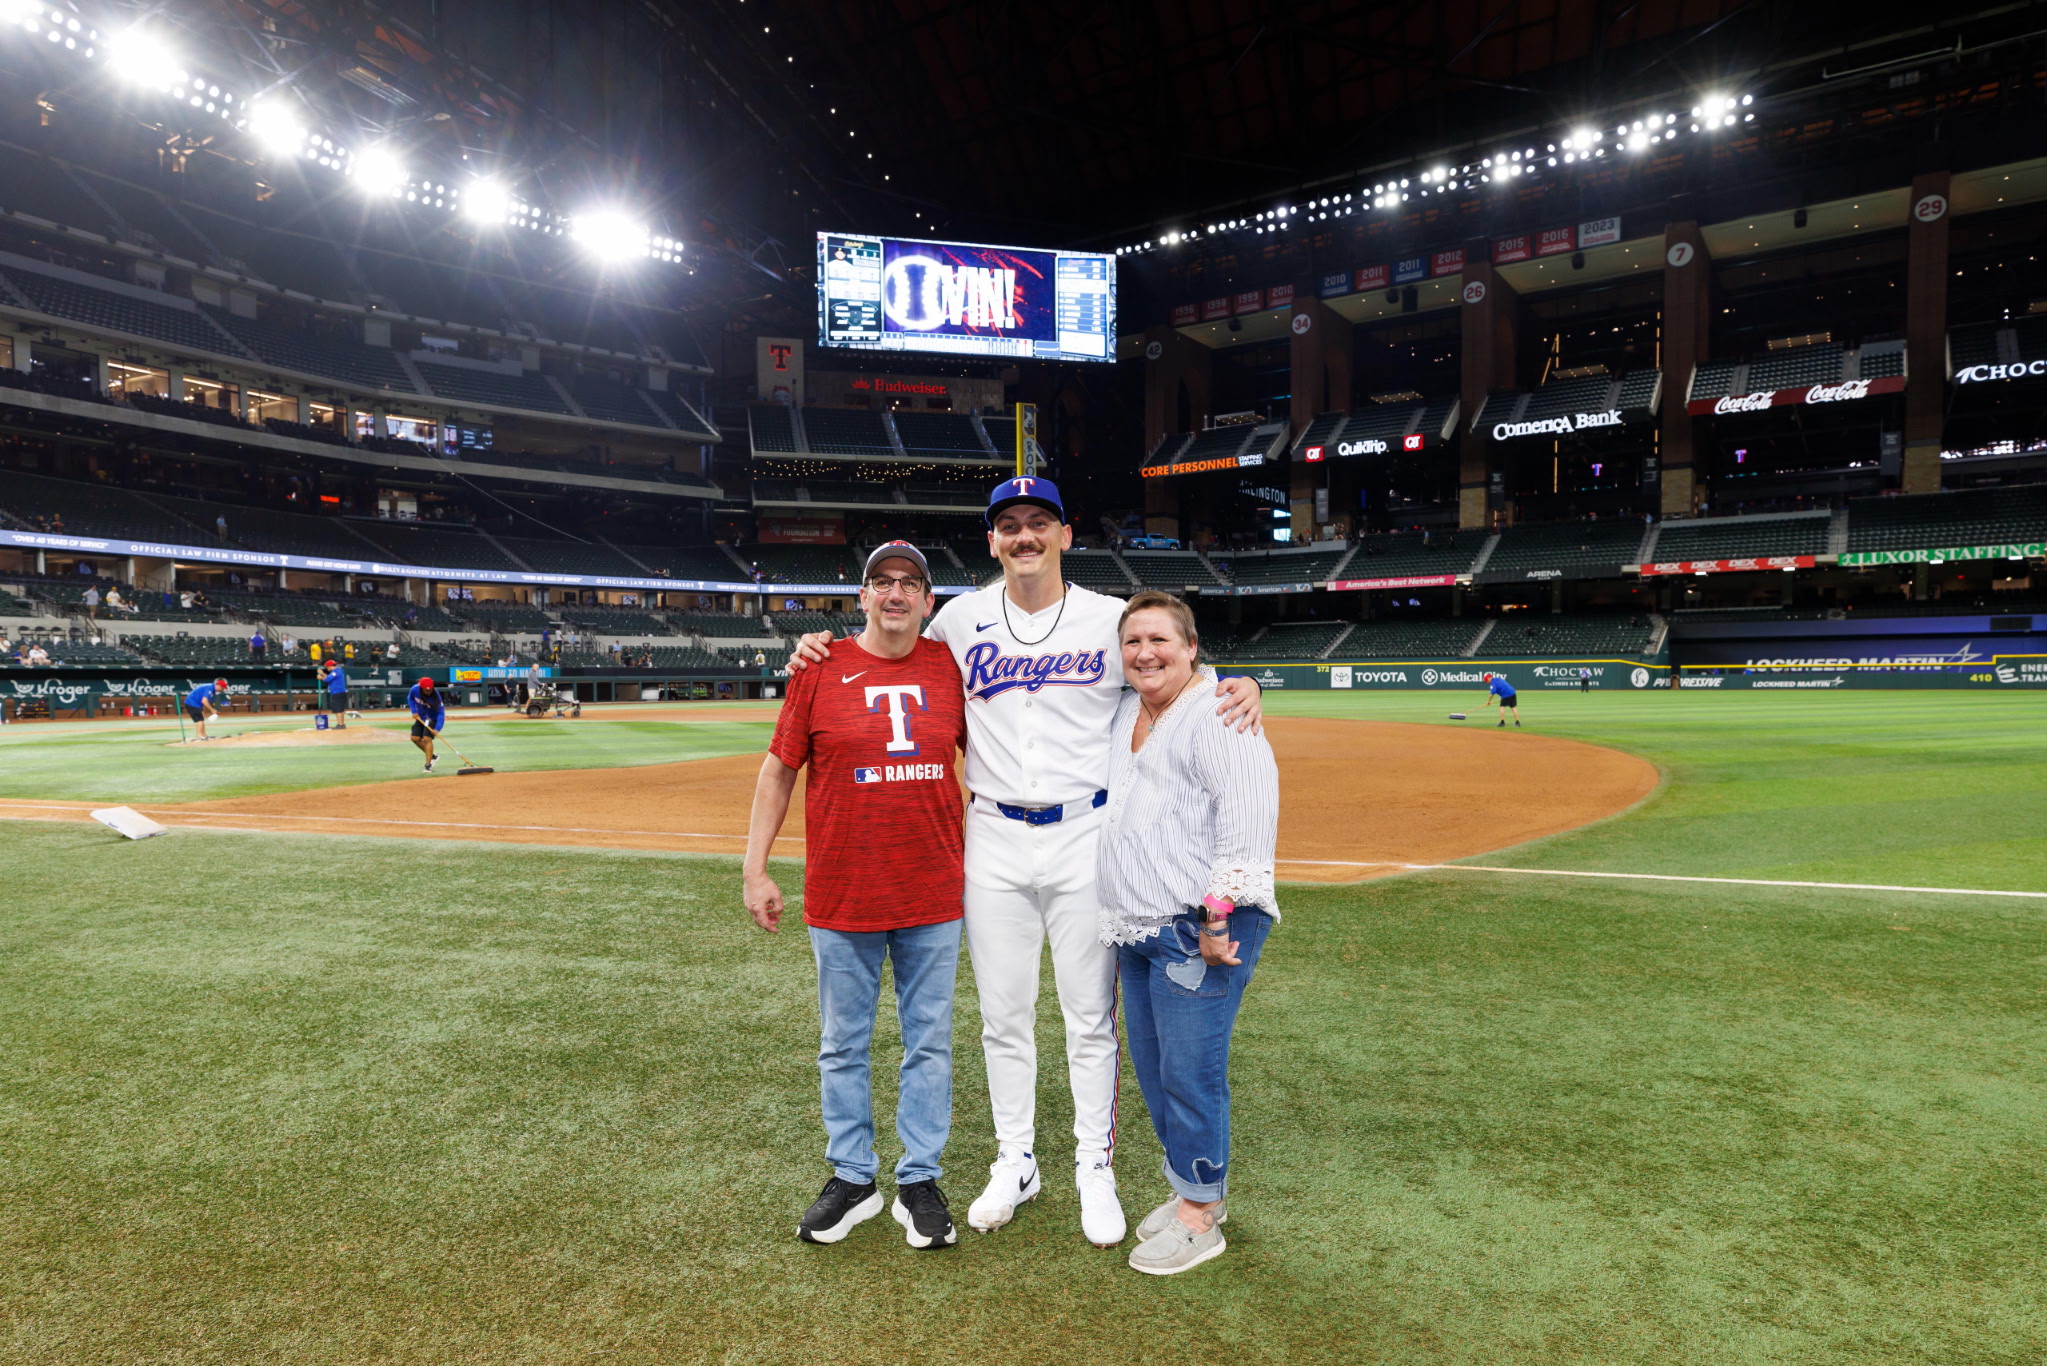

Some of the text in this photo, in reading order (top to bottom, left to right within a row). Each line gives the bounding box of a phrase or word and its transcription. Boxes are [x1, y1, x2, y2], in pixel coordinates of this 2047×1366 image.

[1918, 201, 1943, 216] 29
[1584, 219, 1615, 235] 2023
[1542, 228, 1569, 243] 2016
[1499, 237, 1525, 251] 2015
[1438, 250, 1462, 264] 2012
[1675, 245, 1686, 262] 7
[1399, 258, 1420, 272] 2011
[1362, 266, 1383, 280] 2011
[1324, 274, 1346, 287] 2010
[1272, 285, 1293, 297] 2010
[1466, 285, 1483, 299] 26
[1294, 318, 1309, 330] 34
[768, 344, 792, 371] T
[1970, 360, 2047, 382] CHOC
[1805, 379, 1872, 404] Coca-Cola
[1715, 391, 1776, 415] Coca-Cola
[1575, 409, 1622, 429] Bank
[1338, 439, 1387, 456] QuikTrip
[1405, 436, 1420, 448] QT
[1238, 453, 1263, 461] STAFFING
[1307, 448, 1321, 460] QT
[1141, 457, 1238, 477] CORE PERSONNEL
[1239, 459, 1262, 467] SERVICES
[1013, 478, 1036, 496] T
[47, 538, 68, 546] YEARS
[131, 544, 177, 555] OFFICIAL
[182, 549, 202, 557] LAW
[233, 553, 275, 563] SPONSOR
[1767, 556, 1796, 565] DEX
[1858, 543, 2040, 565] LUXOR STAFFING
[1654, 563, 1681, 571] DEX
[1690, 561, 1718, 569] DEX
[1729, 559, 1757, 568] DEX
[1527, 570, 1562, 578] ARENA
[1345, 580, 1387, 589] America's
[1408, 576, 1446, 585] Network
[964, 641, 1108, 702] Rangers
[1745, 657, 1944, 673] LOCKHEED MARTIN
[488, 669, 505, 677] HOW
[1355, 672, 1407, 682] TOYOTA
[1440, 671, 1482, 682] Medical
[1970, 674, 1993, 682] 410
[37, 679, 91, 703] Kroger
[1753, 680, 1795, 688] LOCKHEED
[864, 685, 929, 757] T
[885, 764, 944, 782] RANGERS
